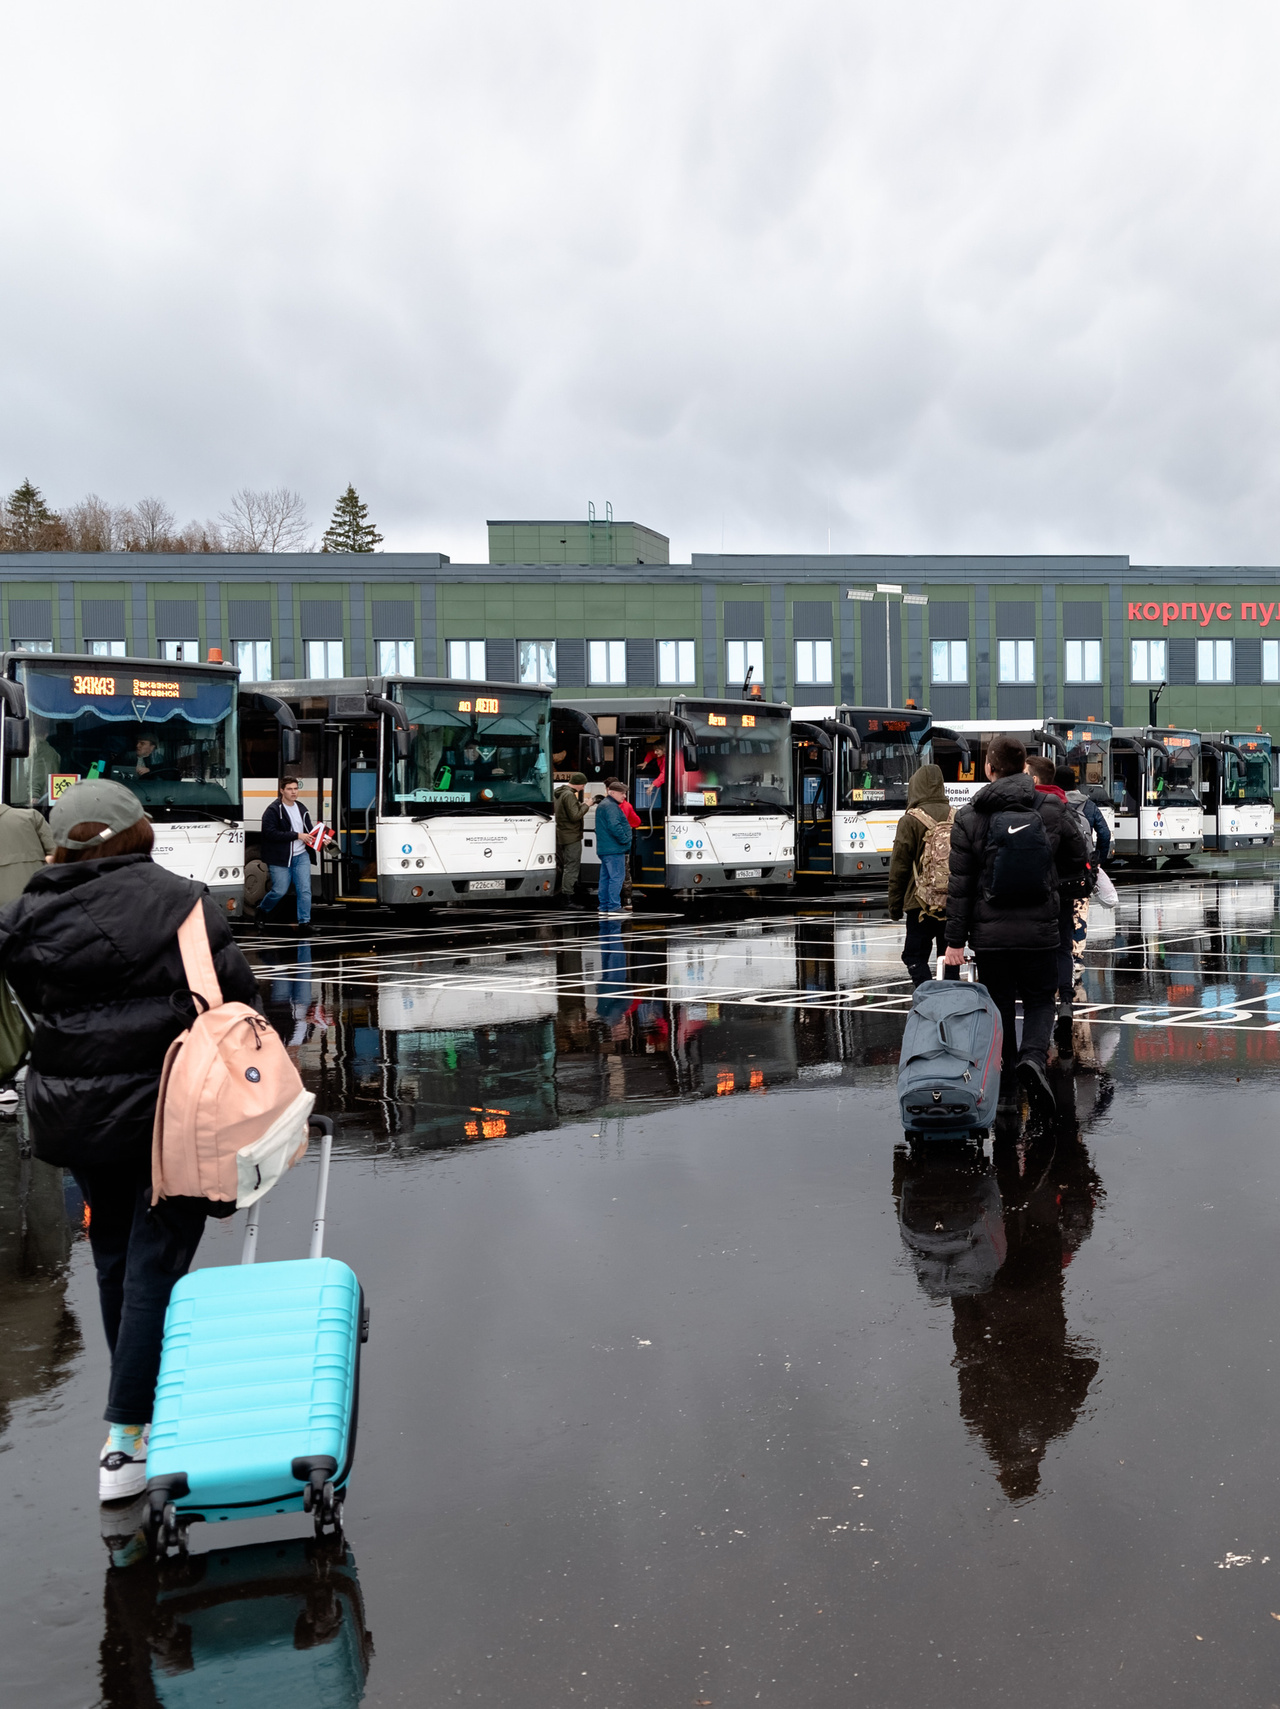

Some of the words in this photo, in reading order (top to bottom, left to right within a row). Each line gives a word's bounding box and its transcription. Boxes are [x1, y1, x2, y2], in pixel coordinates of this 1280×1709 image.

[1128, 602, 1233, 626] корпус
[73, 676, 115, 696] ЗАКАЗ
[422, 794, 466, 802] ЗАКАЗНОЙ
[670, 825, 689, 835] 249
